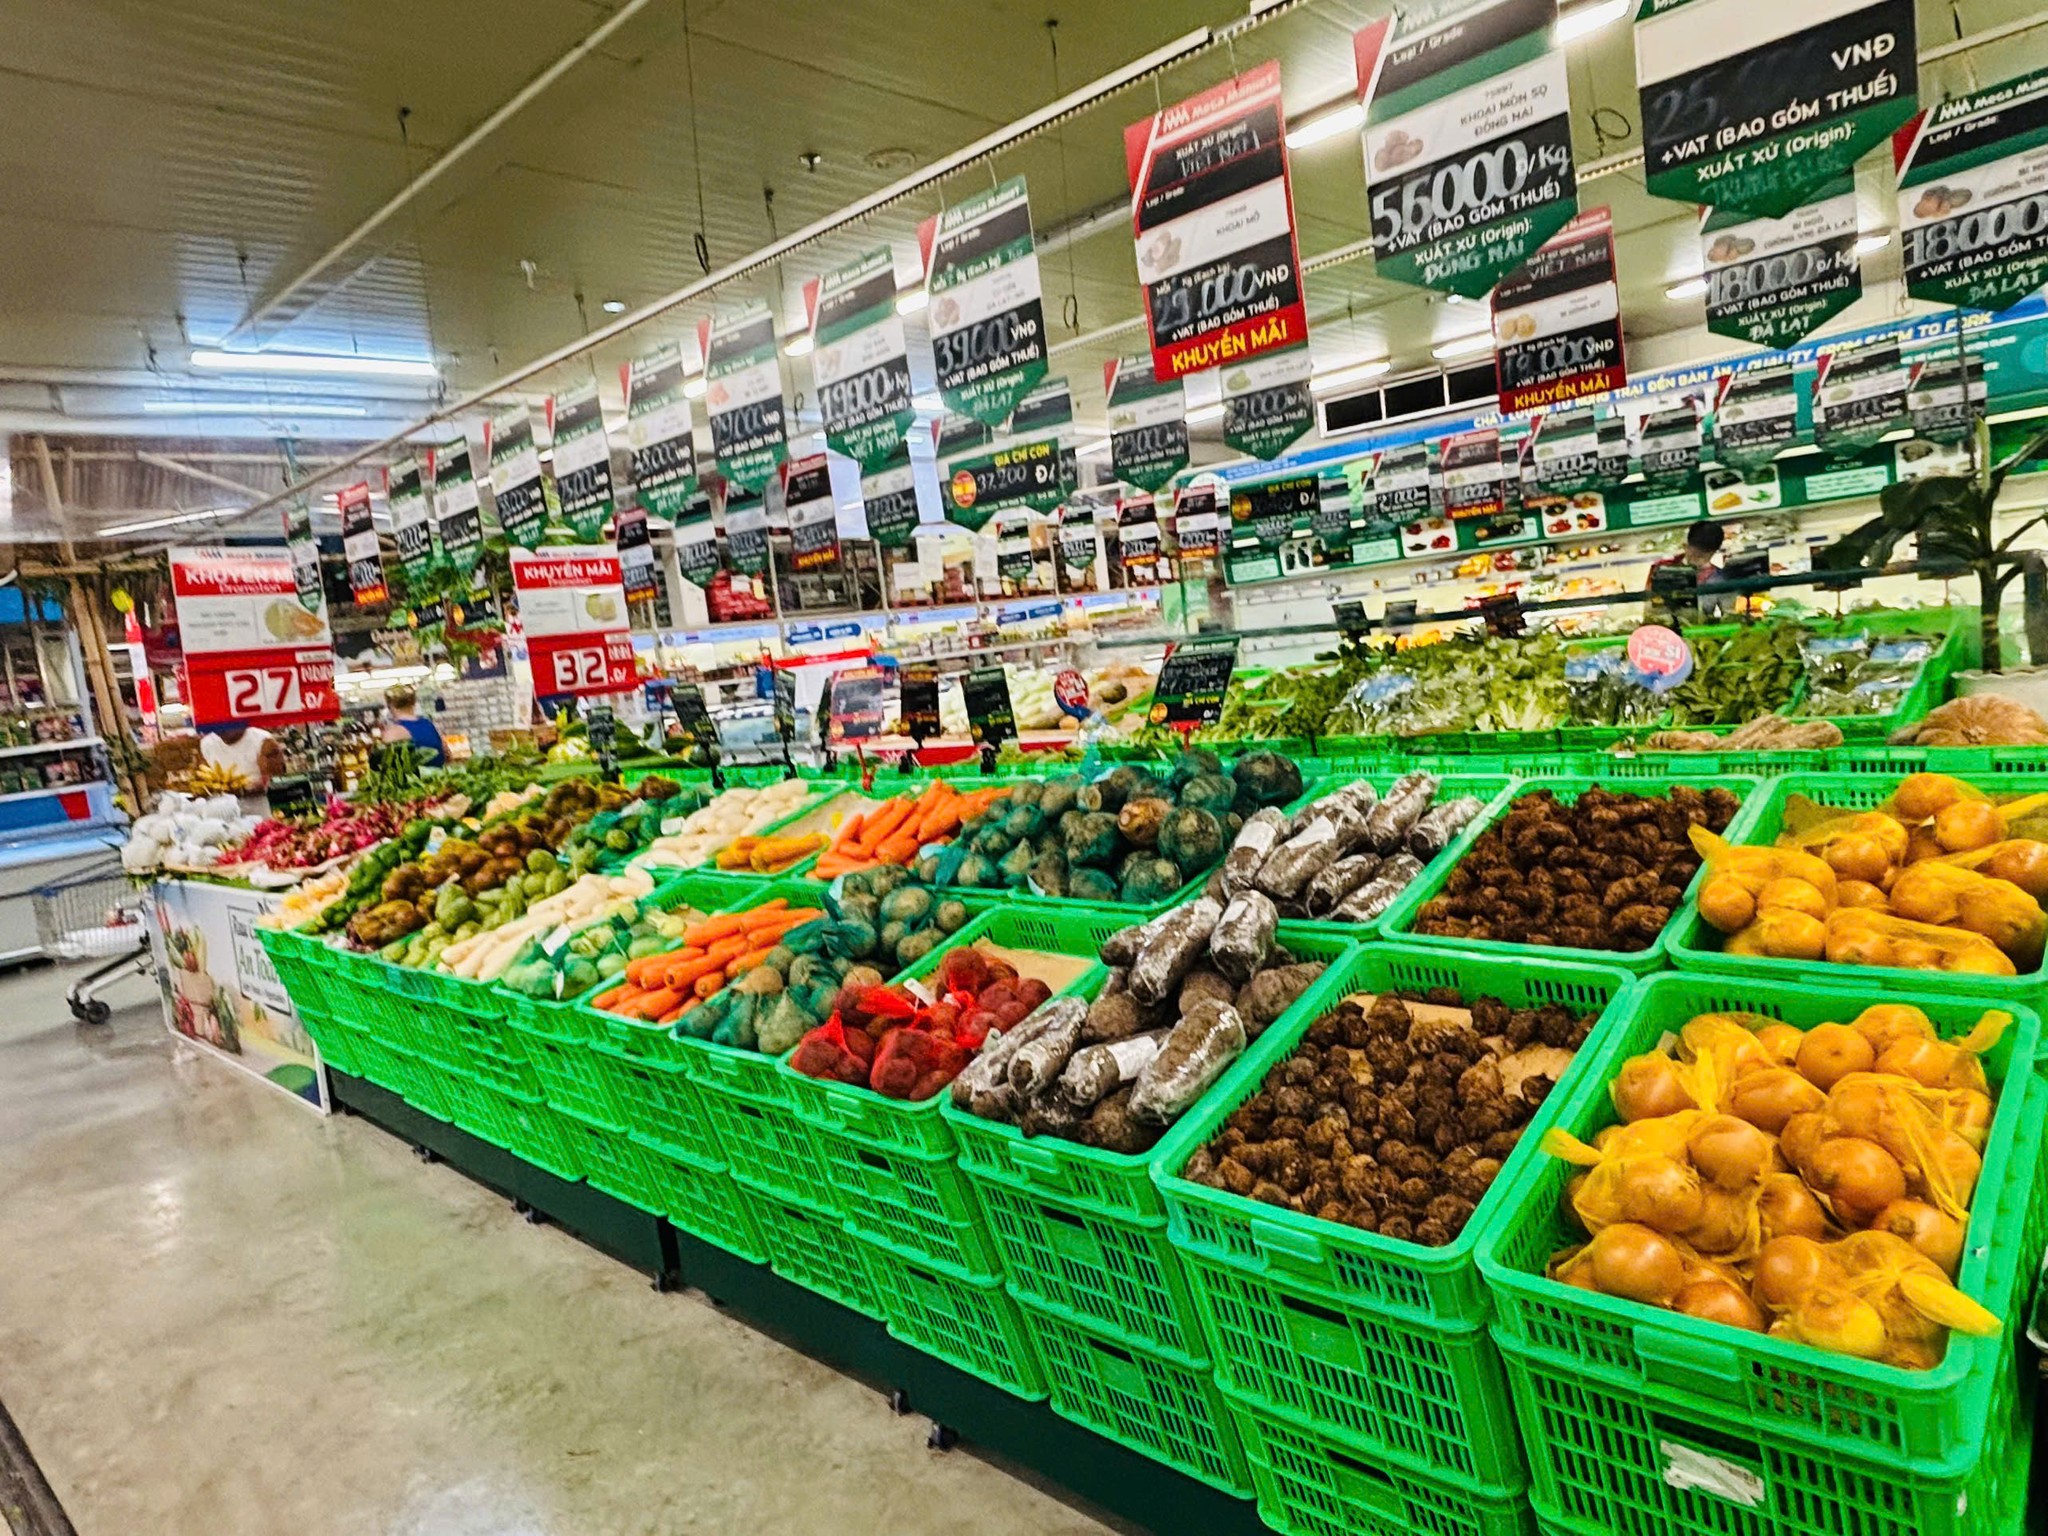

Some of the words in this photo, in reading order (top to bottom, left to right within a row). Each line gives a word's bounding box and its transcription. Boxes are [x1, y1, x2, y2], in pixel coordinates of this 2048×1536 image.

[1831, 32, 1896, 71] VNĐ
[1661, 133, 1711, 166] +VAT
[1715, 117, 1767, 151] (BAO
[1826, 68, 1898, 111] THUẾ)
[1697, 152, 1746, 183] XUẤT
[1428, 213, 1465, 240] (BAO
[1255, 263, 1289, 290] VNĐ
[1920, 260, 1954, 279] +VAT
[1958, 249, 1995, 270] (BAO
[1747, 293, 1777, 311] (BAO
[1251, 316, 1288, 350] MÃI
[1580, 372, 1611, 394] MÃI
[556, 651, 605, 687] 32
[232, 670, 294, 713] 27
